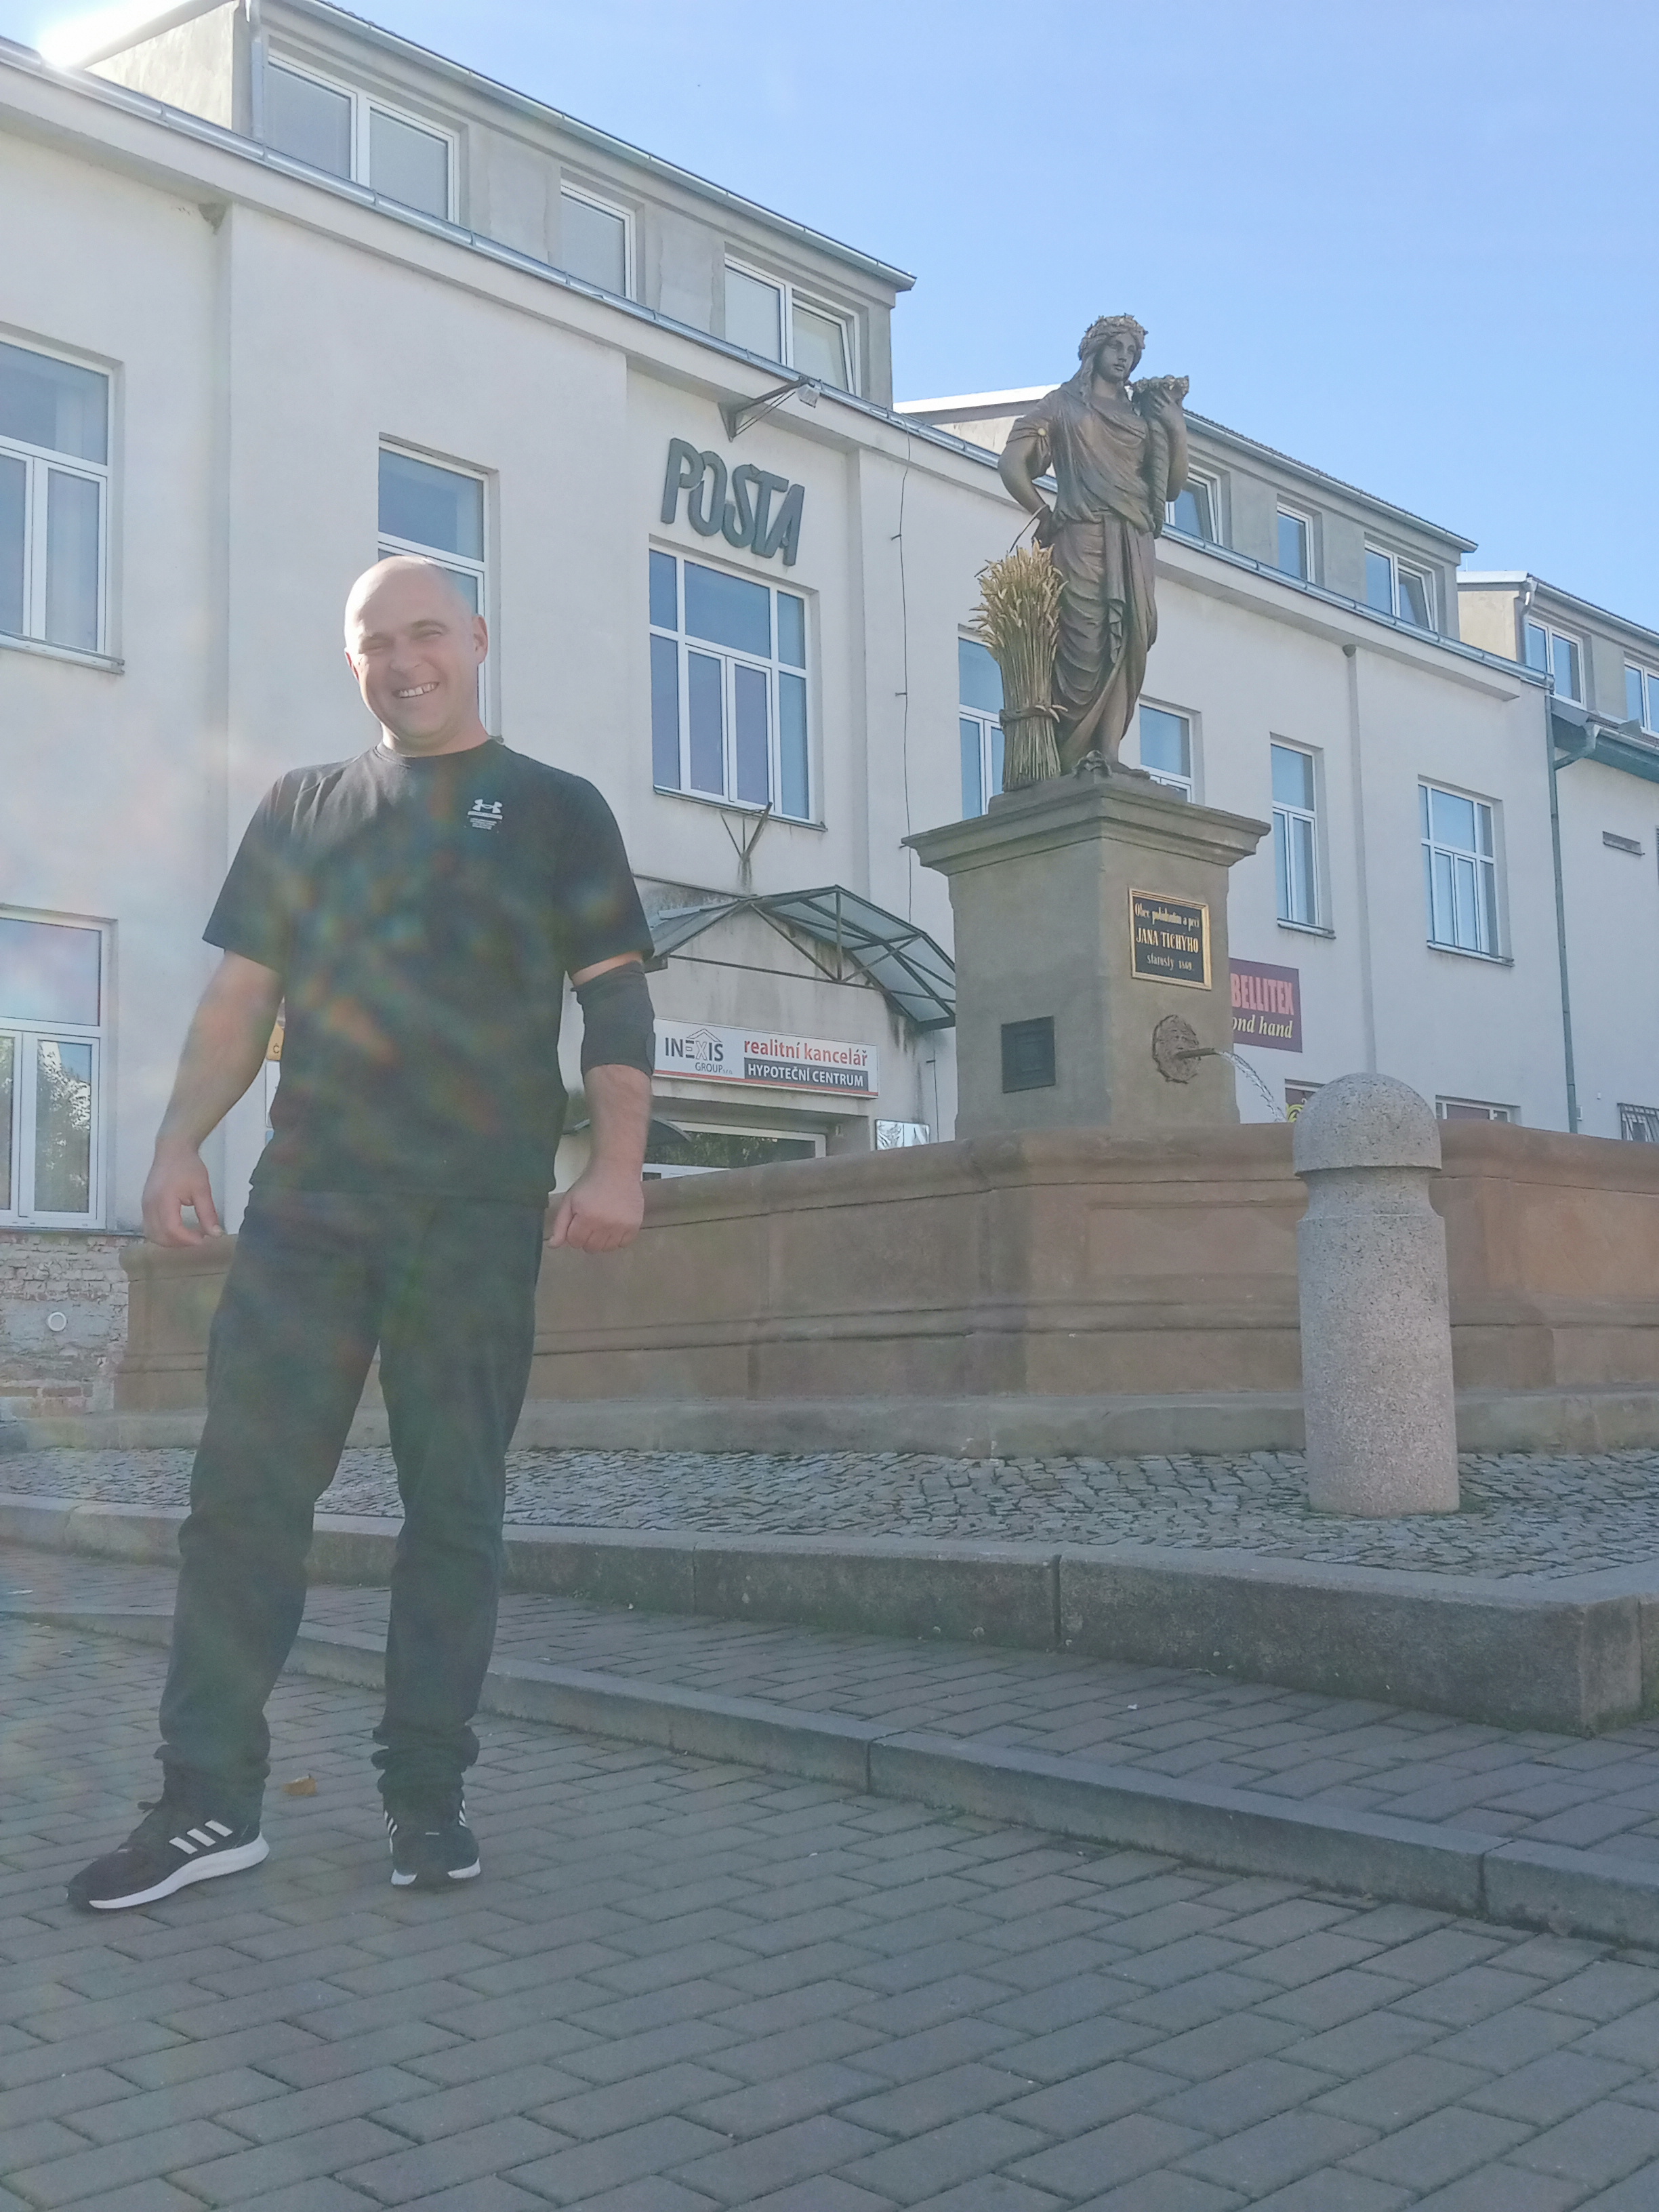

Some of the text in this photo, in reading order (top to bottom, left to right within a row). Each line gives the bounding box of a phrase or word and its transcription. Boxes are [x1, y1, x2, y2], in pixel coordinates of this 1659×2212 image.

[1136, 927, 1159, 946] JANA
[1147, 952, 1174, 971] starosty
[1230, 973, 1294, 1016] BELLITEX
[1258, 1016, 1293, 1039] hand
[665, 1037, 868, 1067] INEXIS realitní kancelář
[695, 1062, 723, 1073] GROUP
[747, 1064, 864, 1087] HYPOTEČNÍ CENTRUM
